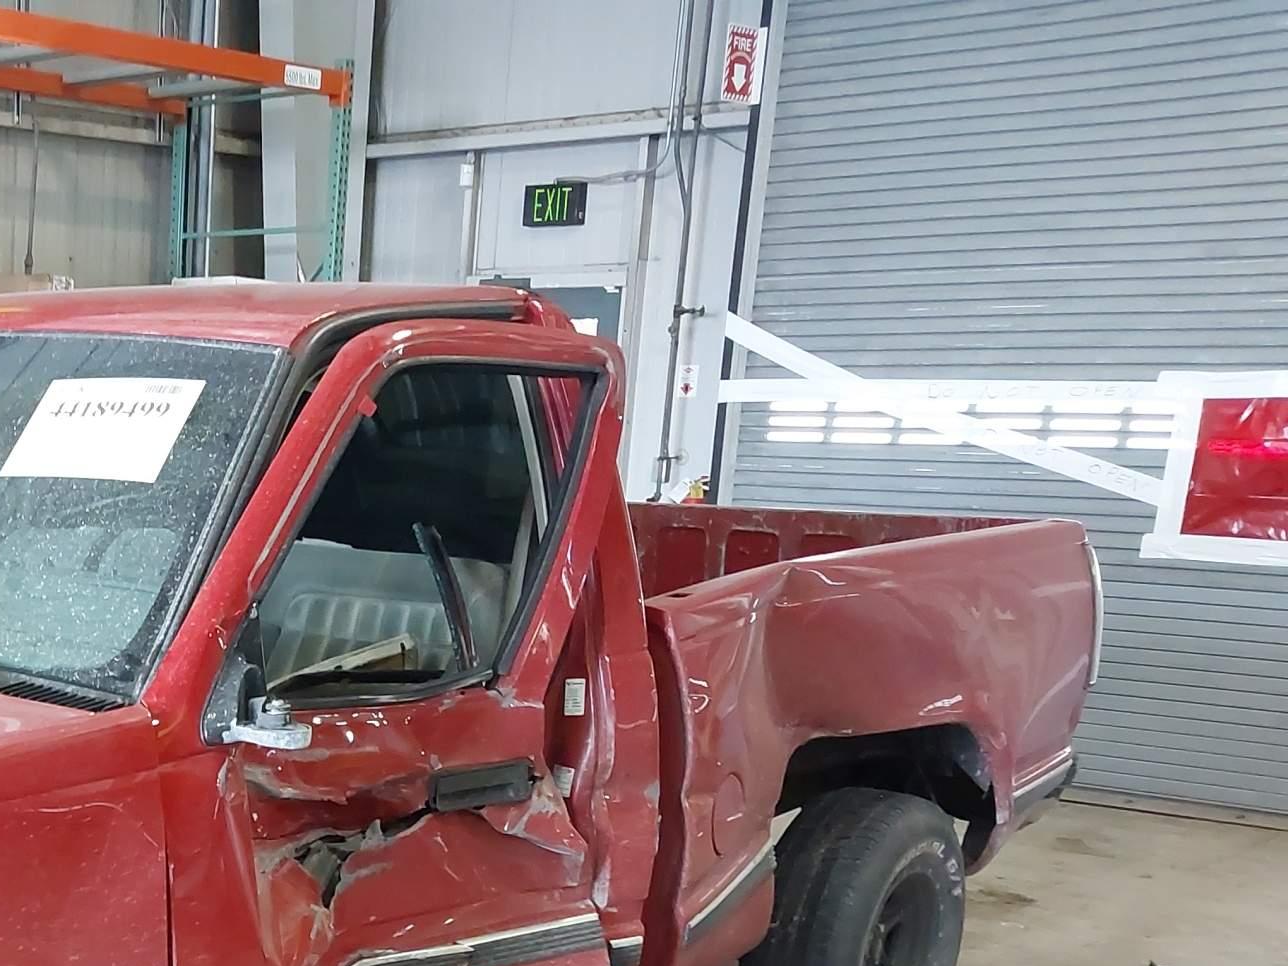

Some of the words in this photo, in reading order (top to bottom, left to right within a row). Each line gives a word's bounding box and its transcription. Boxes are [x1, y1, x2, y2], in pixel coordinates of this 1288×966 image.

[733, 35, 753, 52] FIRE
[533, 187, 573, 222] EXIT
[50, 401, 171, 417] 44189499
